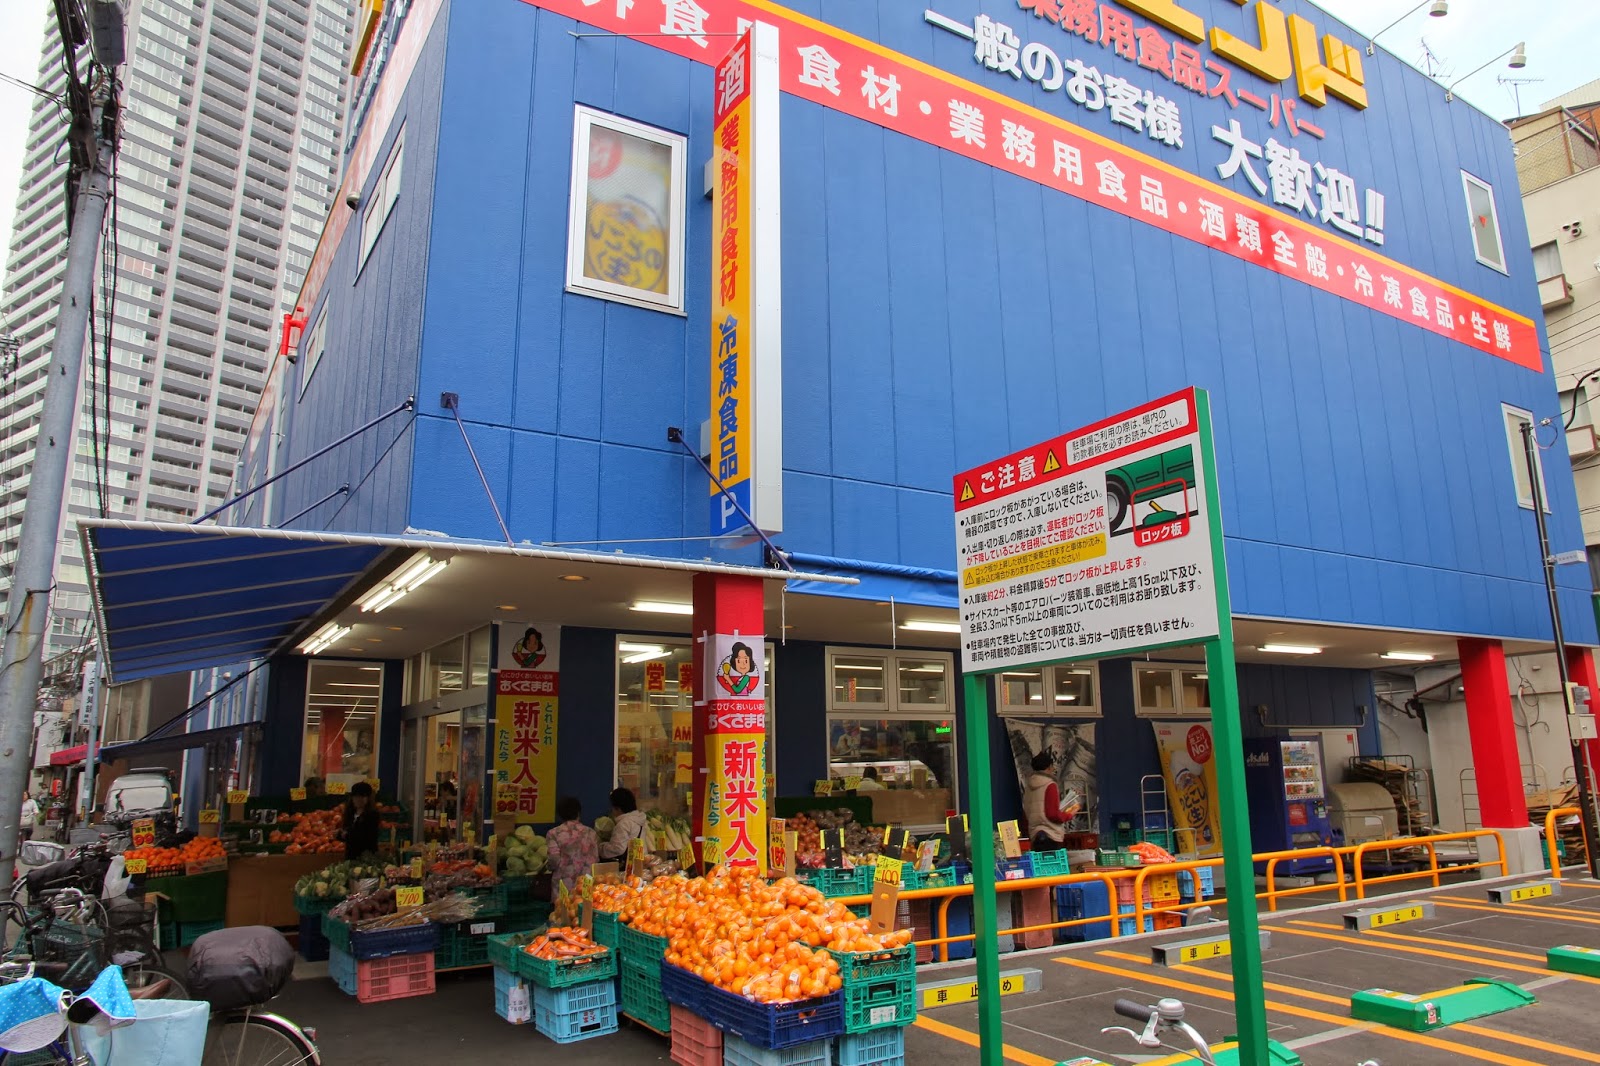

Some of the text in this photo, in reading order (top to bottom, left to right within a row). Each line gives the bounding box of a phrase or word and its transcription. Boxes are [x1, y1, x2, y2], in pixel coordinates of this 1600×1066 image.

[1112, 0, 1368, 110] ンド
[717, 43, 746, 116] 酒
[924, 8, 1184, 149] 一般のお客様
[720, 113, 740, 308] 業務用食材
[718, 313, 739, 484] 冷凍食品
[979, 454, 1037, 495] ご注意
[720, 491, 738, 530] P
[1140, 521, 1183, 544] ロック板
[970, 622, 1085, 651] 駐車場内で発生した全ての事故及び、
[500, 680, 553, 693] おくさま印
[543, 702, 553, 746] とれとれ
[674, 727, 692, 741] AM
[499, 730, 509, 763] ただ今
[708, 781, 720, 827] ただ今
[724, 740, 759, 866] 新米入
[1377, 909, 1417, 925] 車止め
